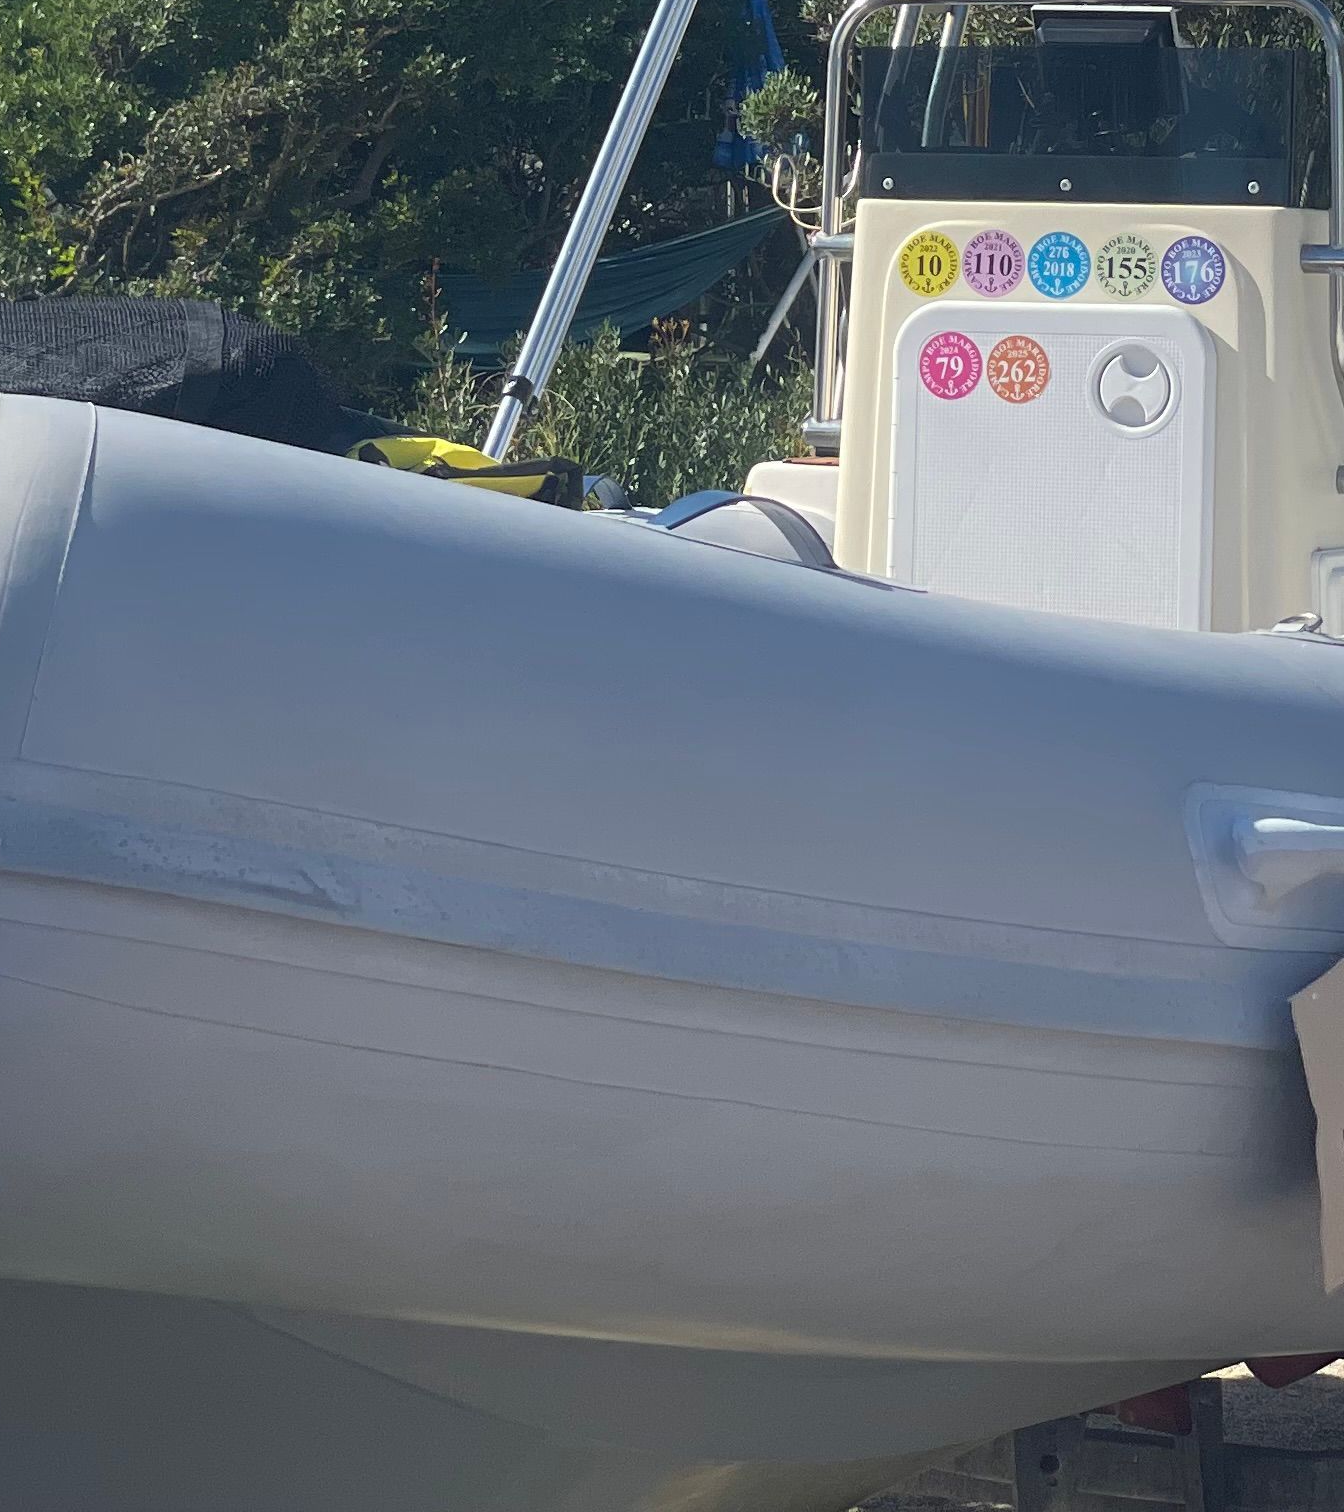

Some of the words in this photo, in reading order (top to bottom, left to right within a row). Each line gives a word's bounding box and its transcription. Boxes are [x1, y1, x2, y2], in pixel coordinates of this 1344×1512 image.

[907, 233, 928, 253] BOE
[970, 232, 994, 250] BOE
[1036, 234, 1057, 253] BOE
[1102, 235, 1124, 255] BOE
[1168, 238, 1190, 259] BOE
[1048, 246, 1070, 259] 276
[916, 254, 943, 277] 10
[974, 252, 1013, 277] 110
[1043, 261, 1075, 278] 2018
[1105, 256, 1148, 279] 155
[1172, 259, 1215, 284] 176
[926, 335, 947, 356] BOE
[935, 355, 964, 380] 79
[997, 359, 1036, 384] 262
